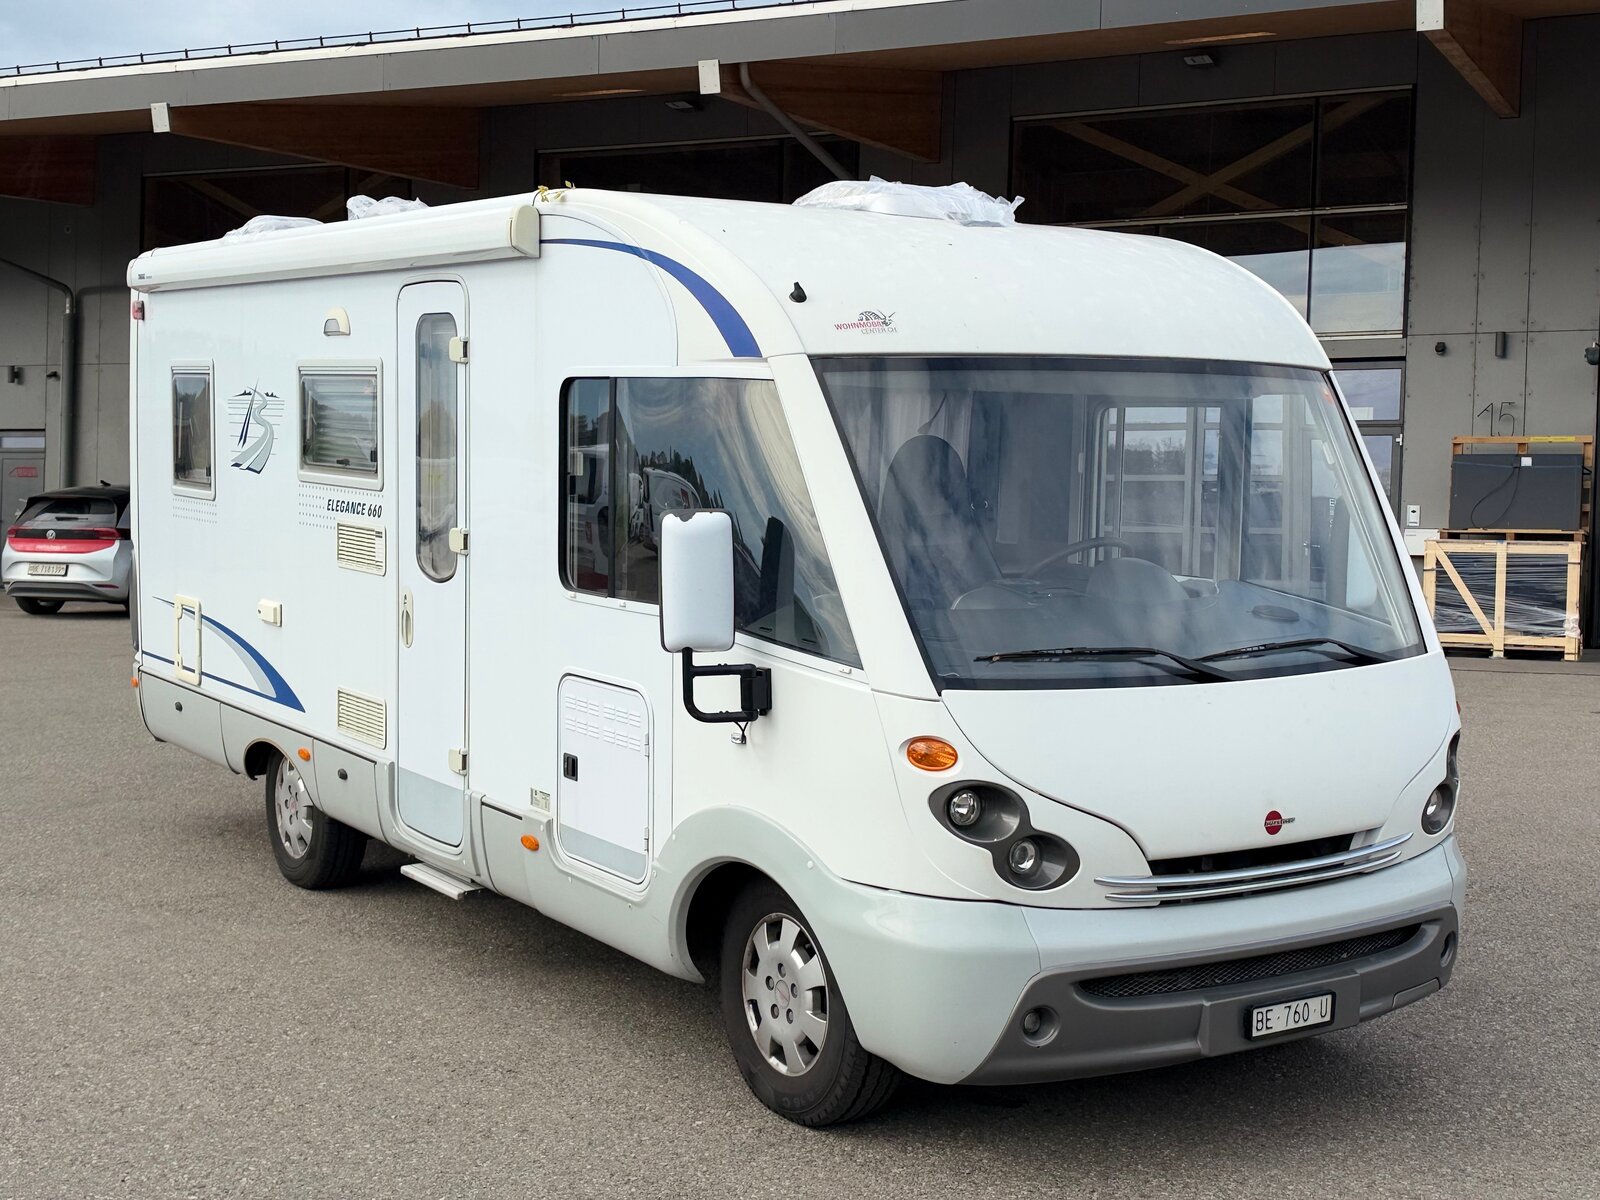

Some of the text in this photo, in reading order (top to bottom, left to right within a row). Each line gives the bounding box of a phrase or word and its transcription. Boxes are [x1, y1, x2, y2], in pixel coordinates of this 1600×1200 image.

[1477, 401, 1516, 437] 15
[326, 499, 383, 518] ELEGANCE 660
